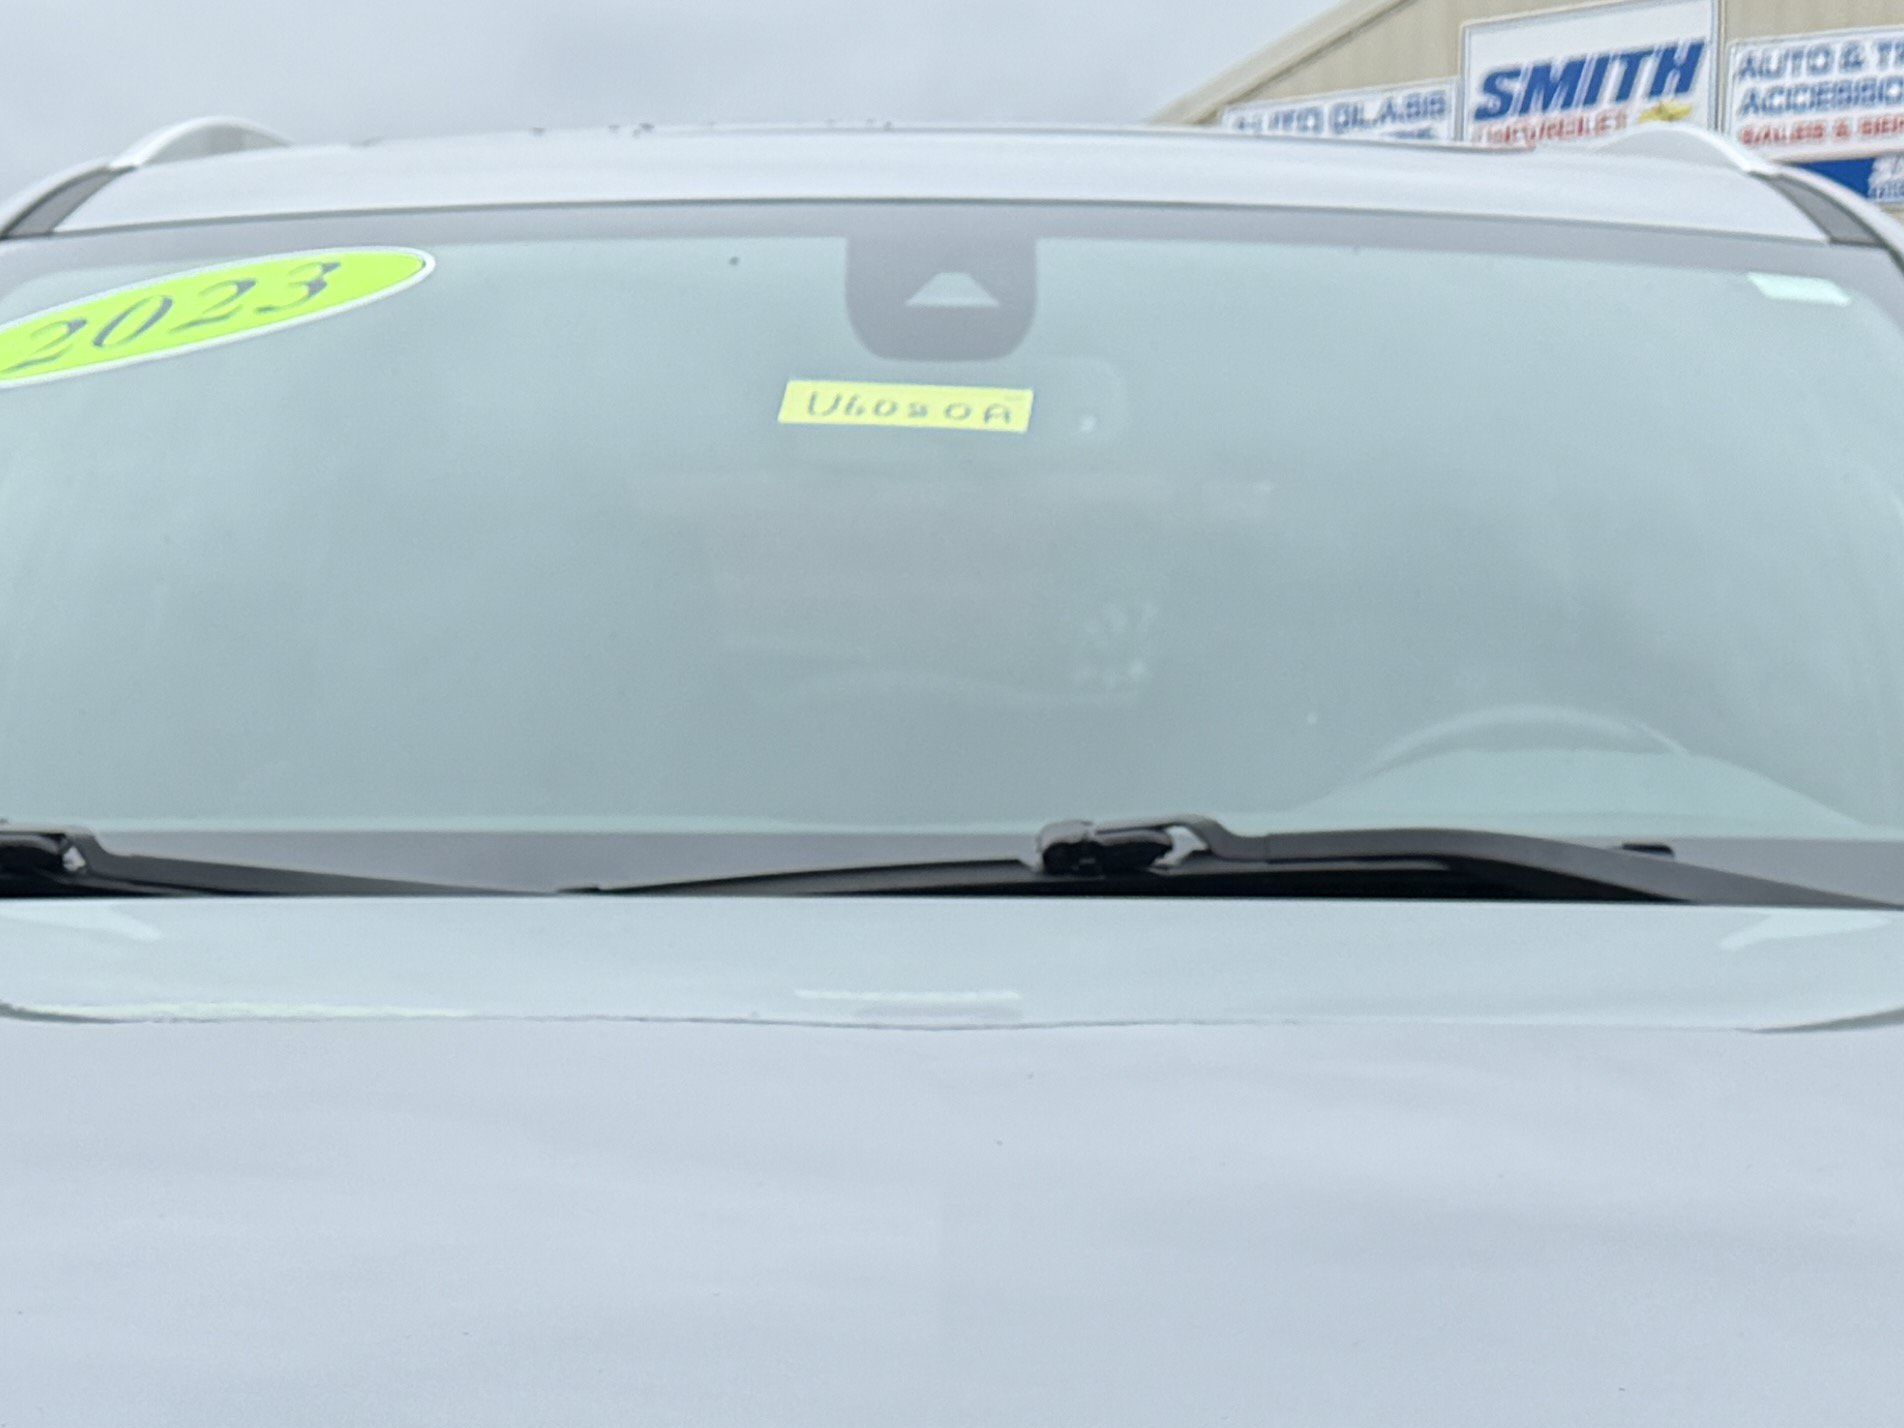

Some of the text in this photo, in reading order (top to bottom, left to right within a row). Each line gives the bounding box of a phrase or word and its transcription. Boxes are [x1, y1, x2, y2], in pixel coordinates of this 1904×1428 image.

[1474, 41, 1706, 121] SMITH
[1737, 46, 1834, 81] AUTO
[1838, 42, 1864, 72] &
[1330, 89, 1448, 136] GLASS
[1739, 123, 1825, 147] SALES
[1831, 118, 1851, 141] &
